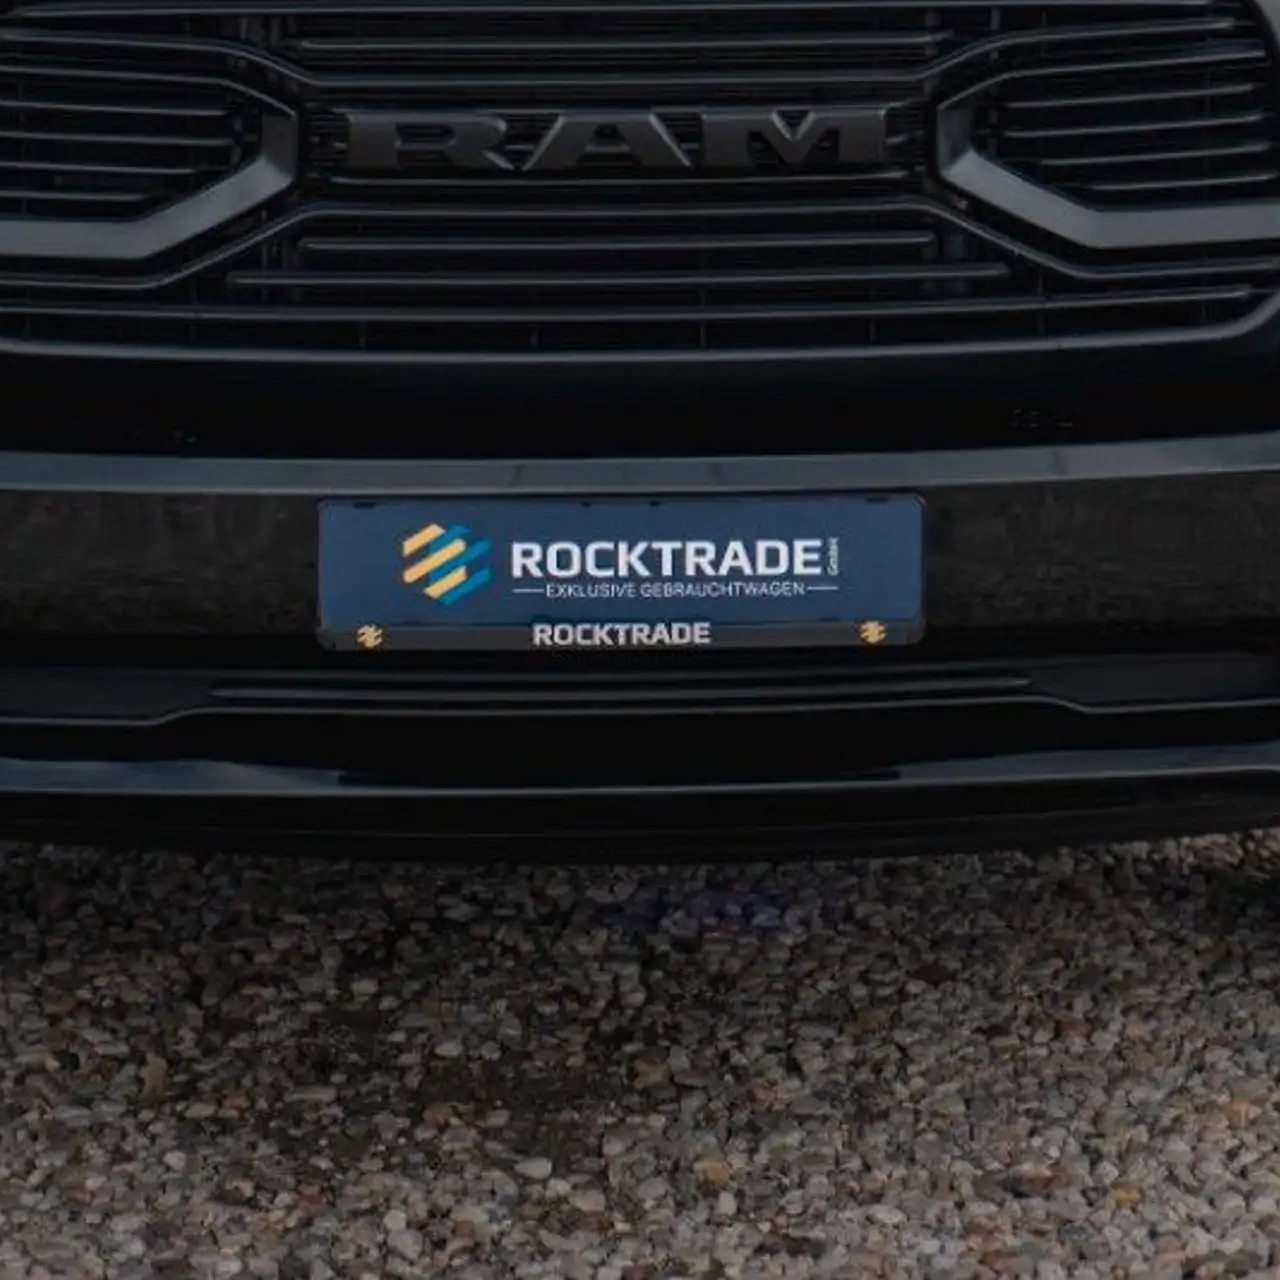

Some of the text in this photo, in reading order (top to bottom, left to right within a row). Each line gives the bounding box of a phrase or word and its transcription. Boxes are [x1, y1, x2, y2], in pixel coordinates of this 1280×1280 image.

[342, 107, 888, 171] RAM
[511, 538, 822, 578] ROCKTRADE
[545, 580, 806, 598] EXKLUSIVE GEBRAUCHTWAGEN
[532, 621, 712, 646] ROCKTRADE
